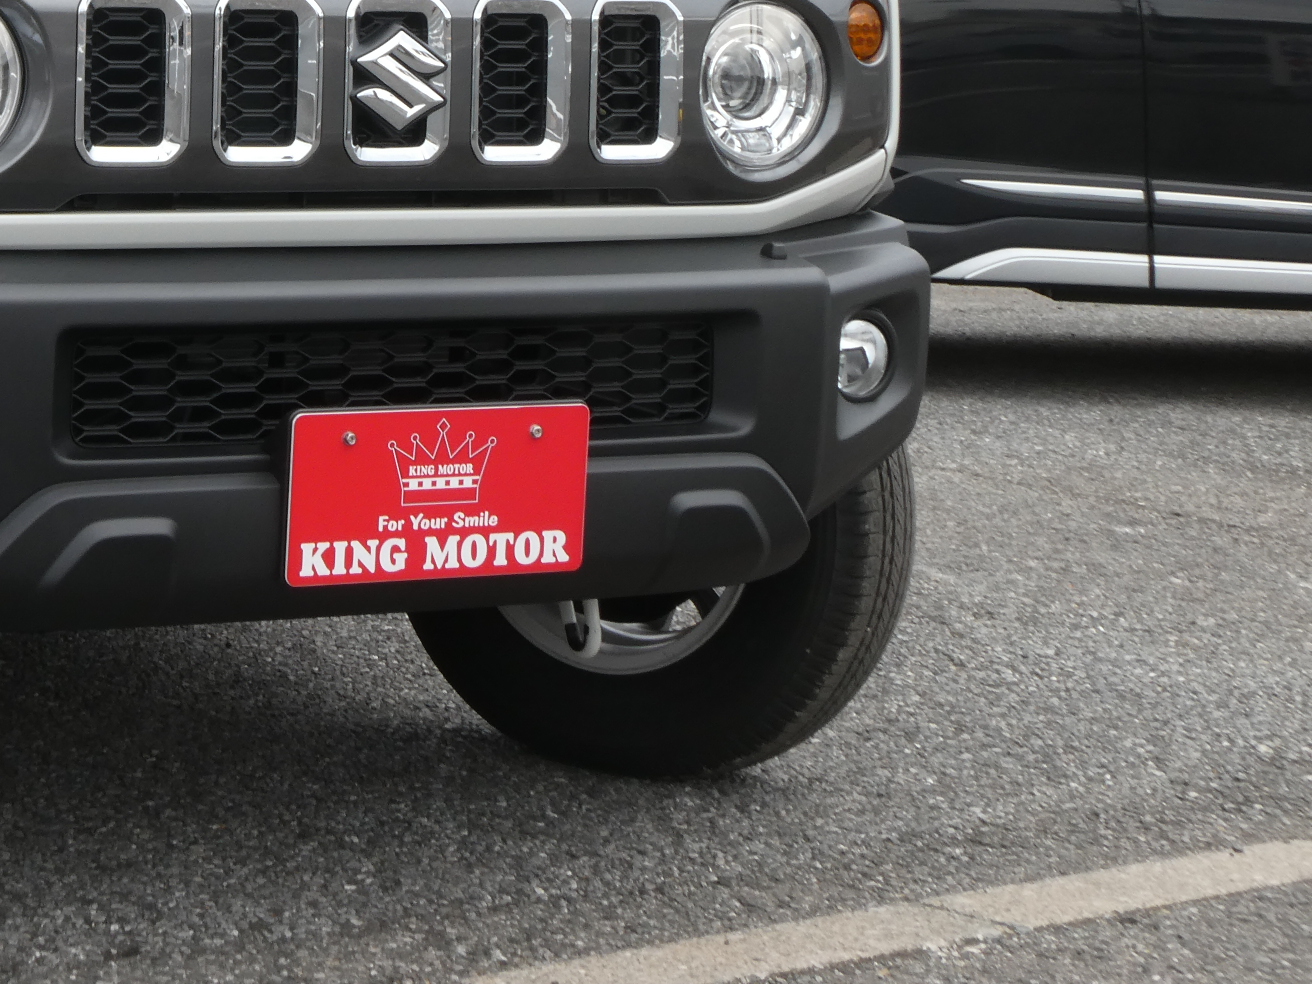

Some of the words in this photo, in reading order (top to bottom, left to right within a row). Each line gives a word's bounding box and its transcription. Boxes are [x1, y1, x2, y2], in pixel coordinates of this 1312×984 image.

[408, 465, 435, 476] KING
[437, 463, 474, 474] MOTOR
[378, 516, 405, 532] For
[410, 513, 447, 530] Your
[452, 511, 498, 527] Smile
[299, 538, 407, 577] KING
[423, 530, 570, 570] MOTOR
